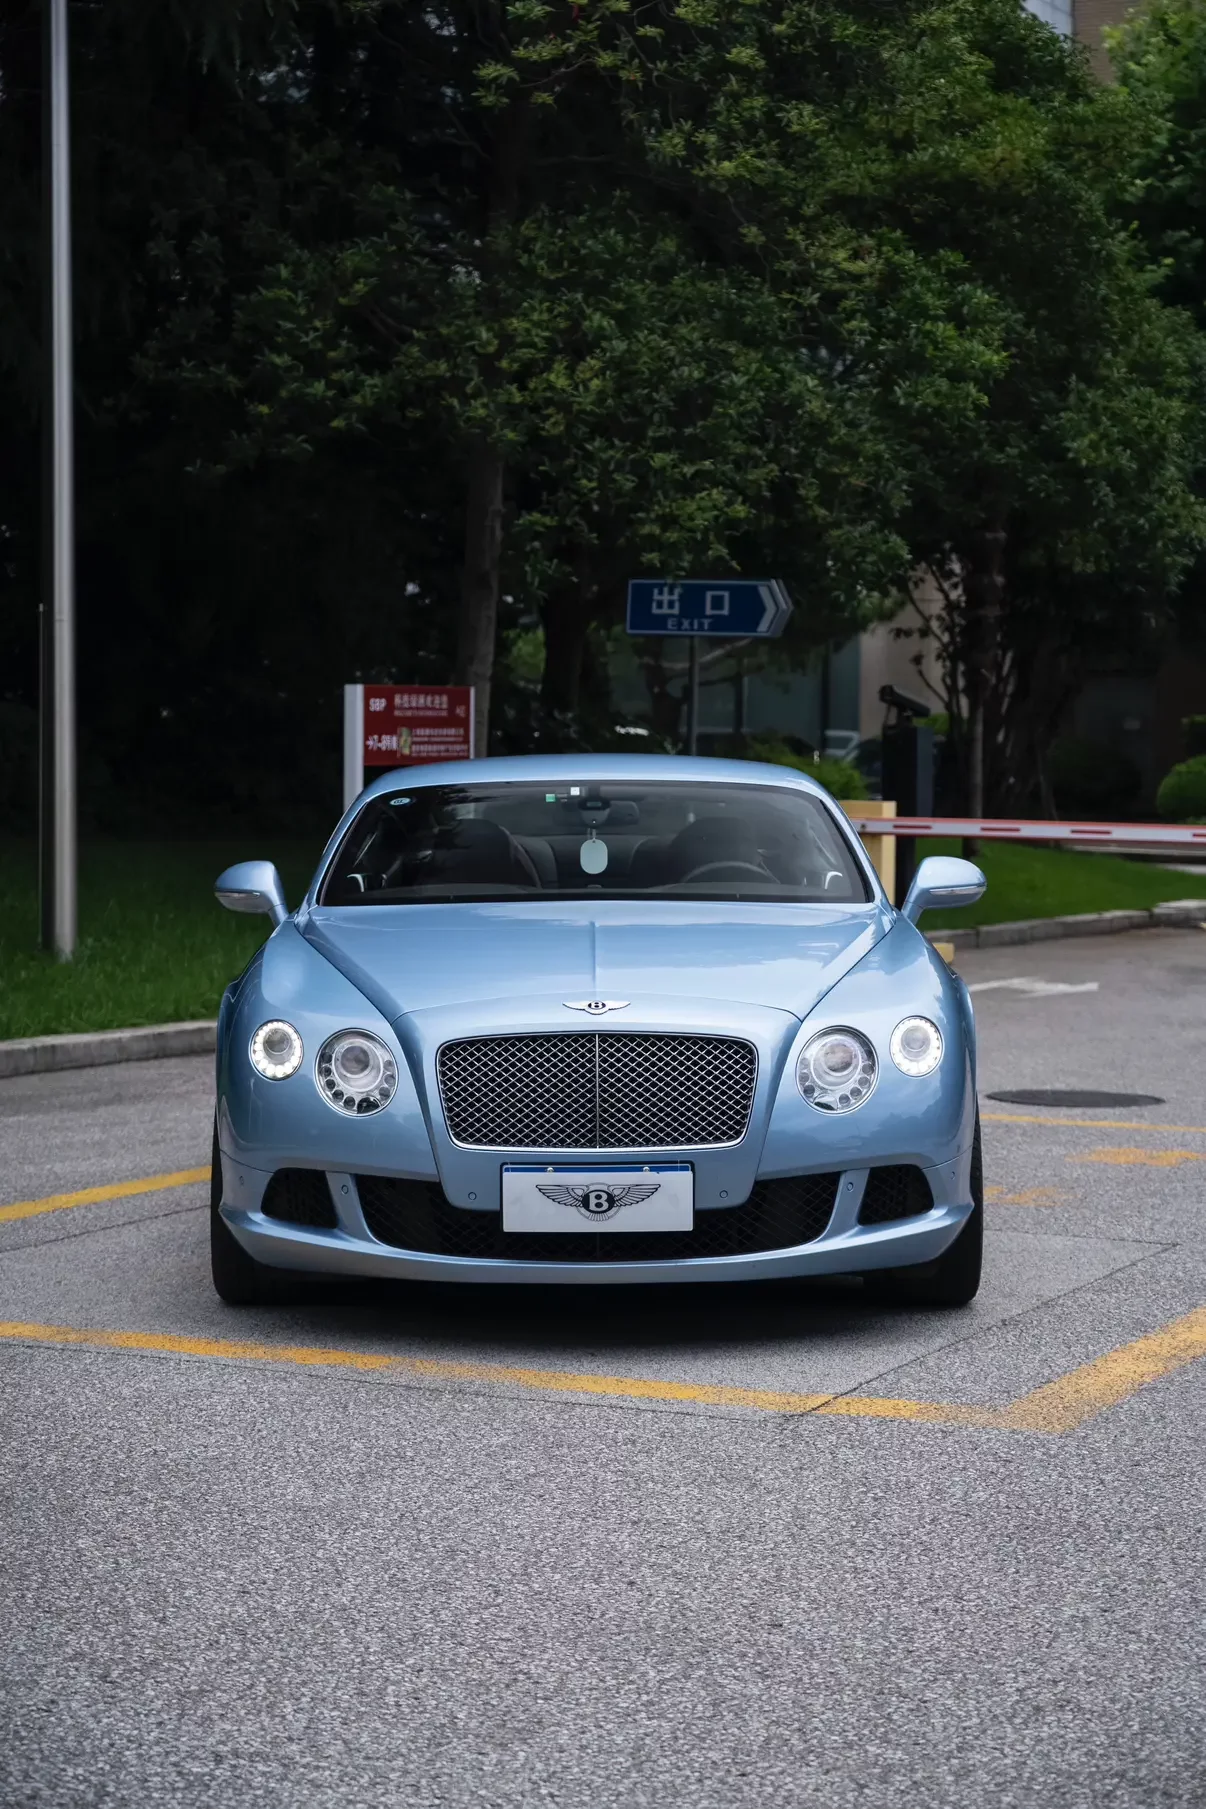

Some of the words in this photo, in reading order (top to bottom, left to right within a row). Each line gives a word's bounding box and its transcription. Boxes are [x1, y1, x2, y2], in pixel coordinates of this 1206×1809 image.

[651, 585, 730, 616] 出口
[666, 617, 713, 631] EXIT
[589, 1191, 609, 1212] B
